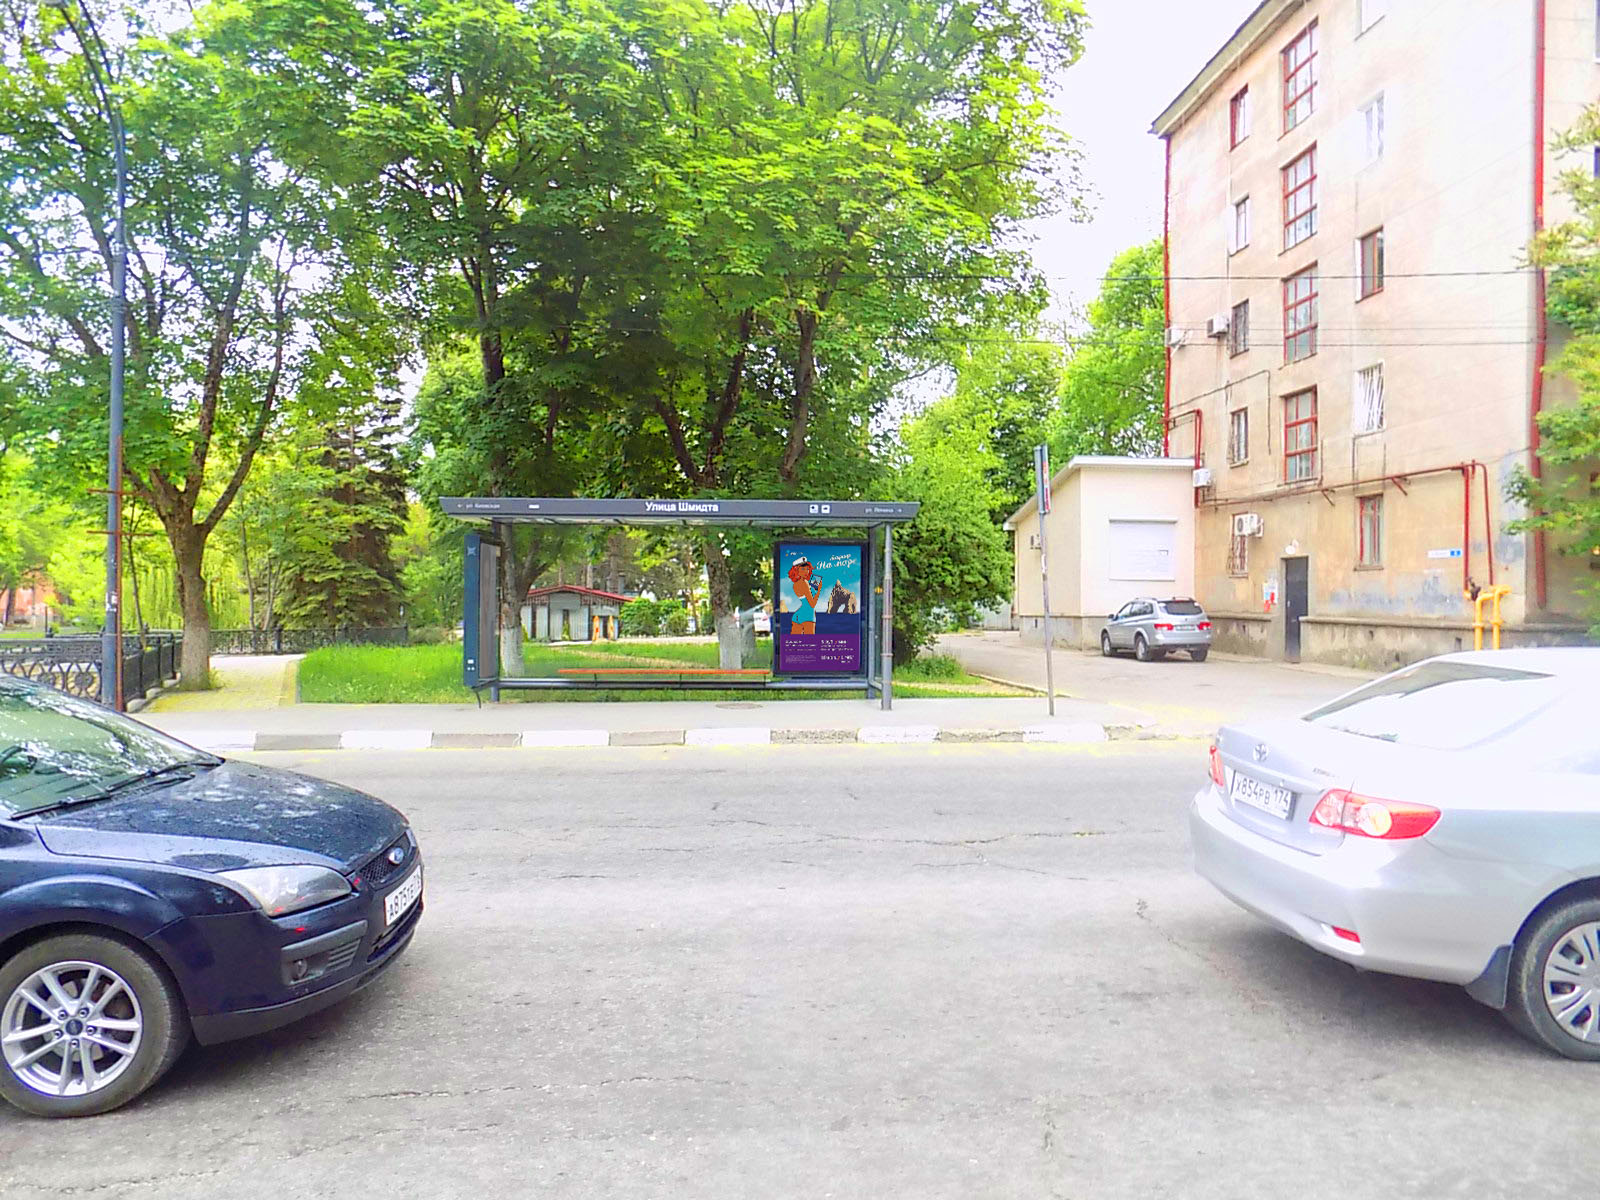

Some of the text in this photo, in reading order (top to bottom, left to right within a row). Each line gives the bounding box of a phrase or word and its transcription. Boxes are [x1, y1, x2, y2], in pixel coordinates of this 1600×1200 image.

[645, 501, 719, 512] Улица Шмидта
[1275, 789, 1289, 807] 174
